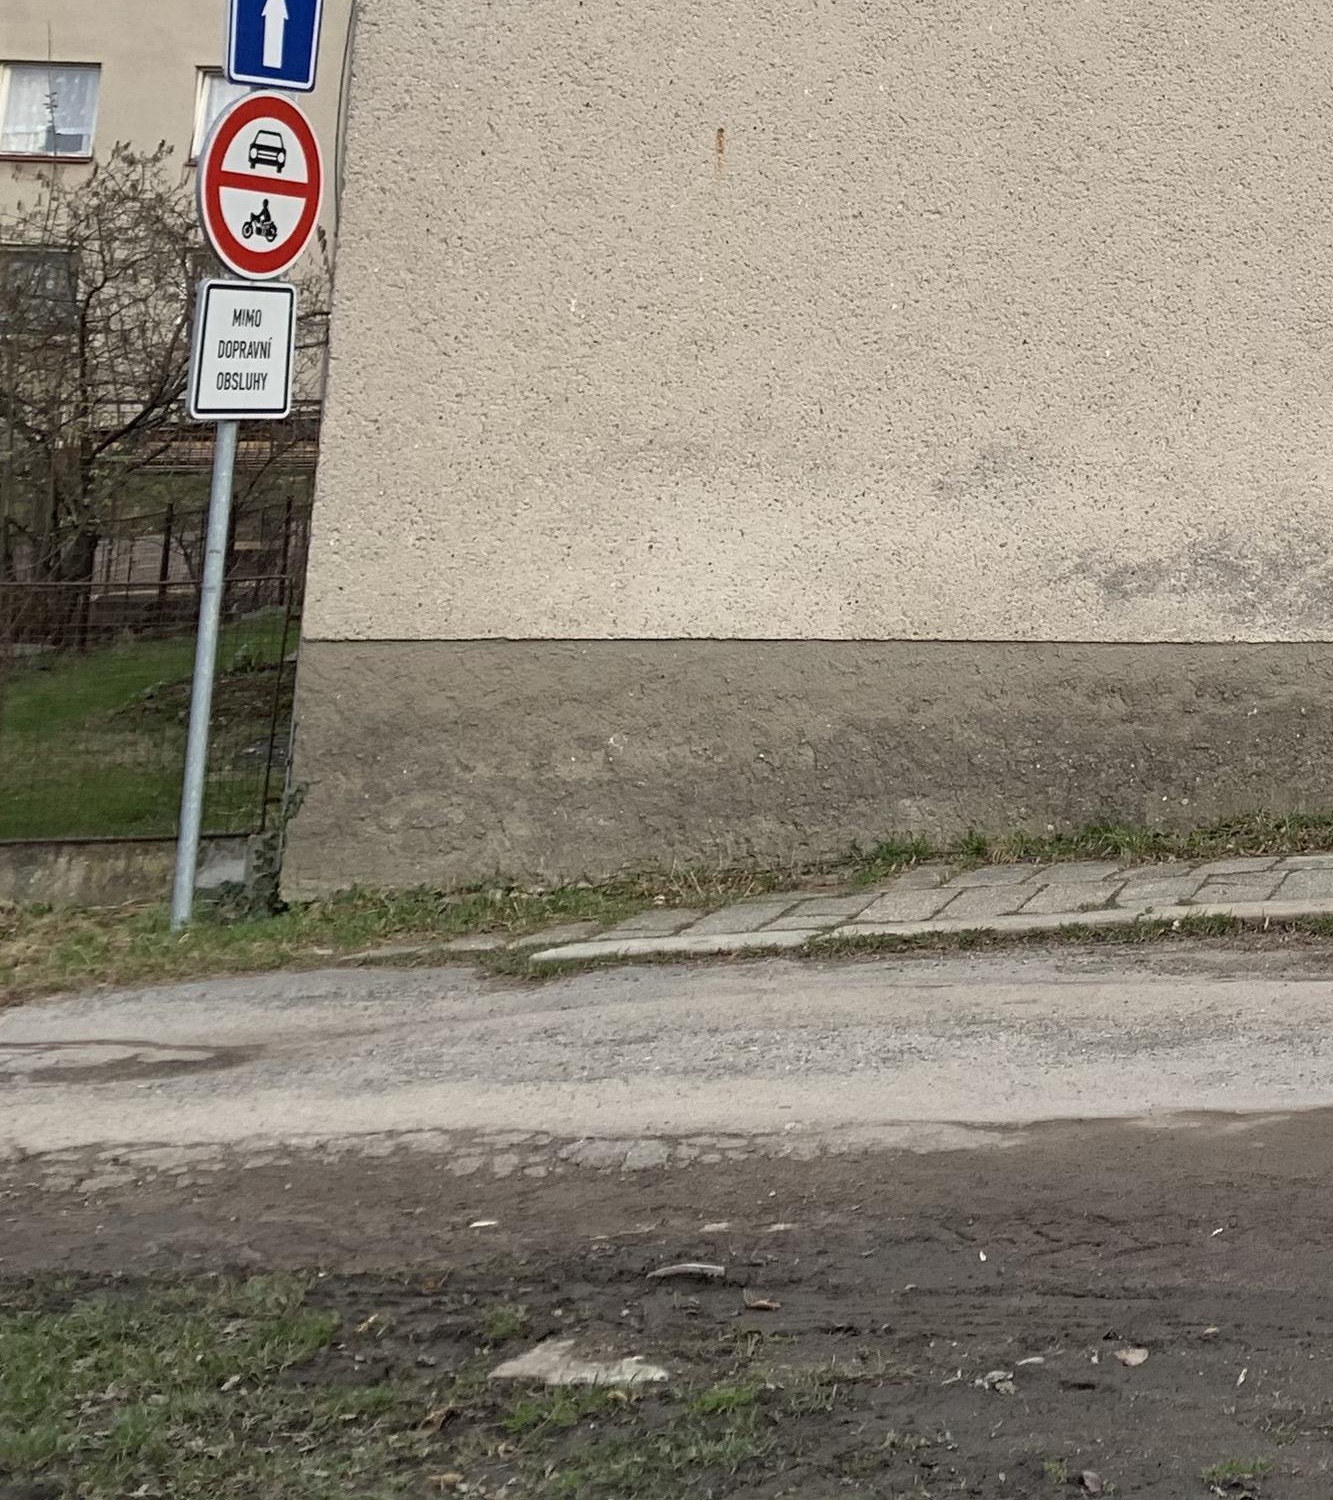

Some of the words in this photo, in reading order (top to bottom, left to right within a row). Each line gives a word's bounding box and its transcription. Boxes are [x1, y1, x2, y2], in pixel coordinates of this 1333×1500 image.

[232, 308, 262, 328] MIMO
[217, 337, 272, 359] DOPRAVNÍ
[216, 372, 268, 391] OBSLUHY
